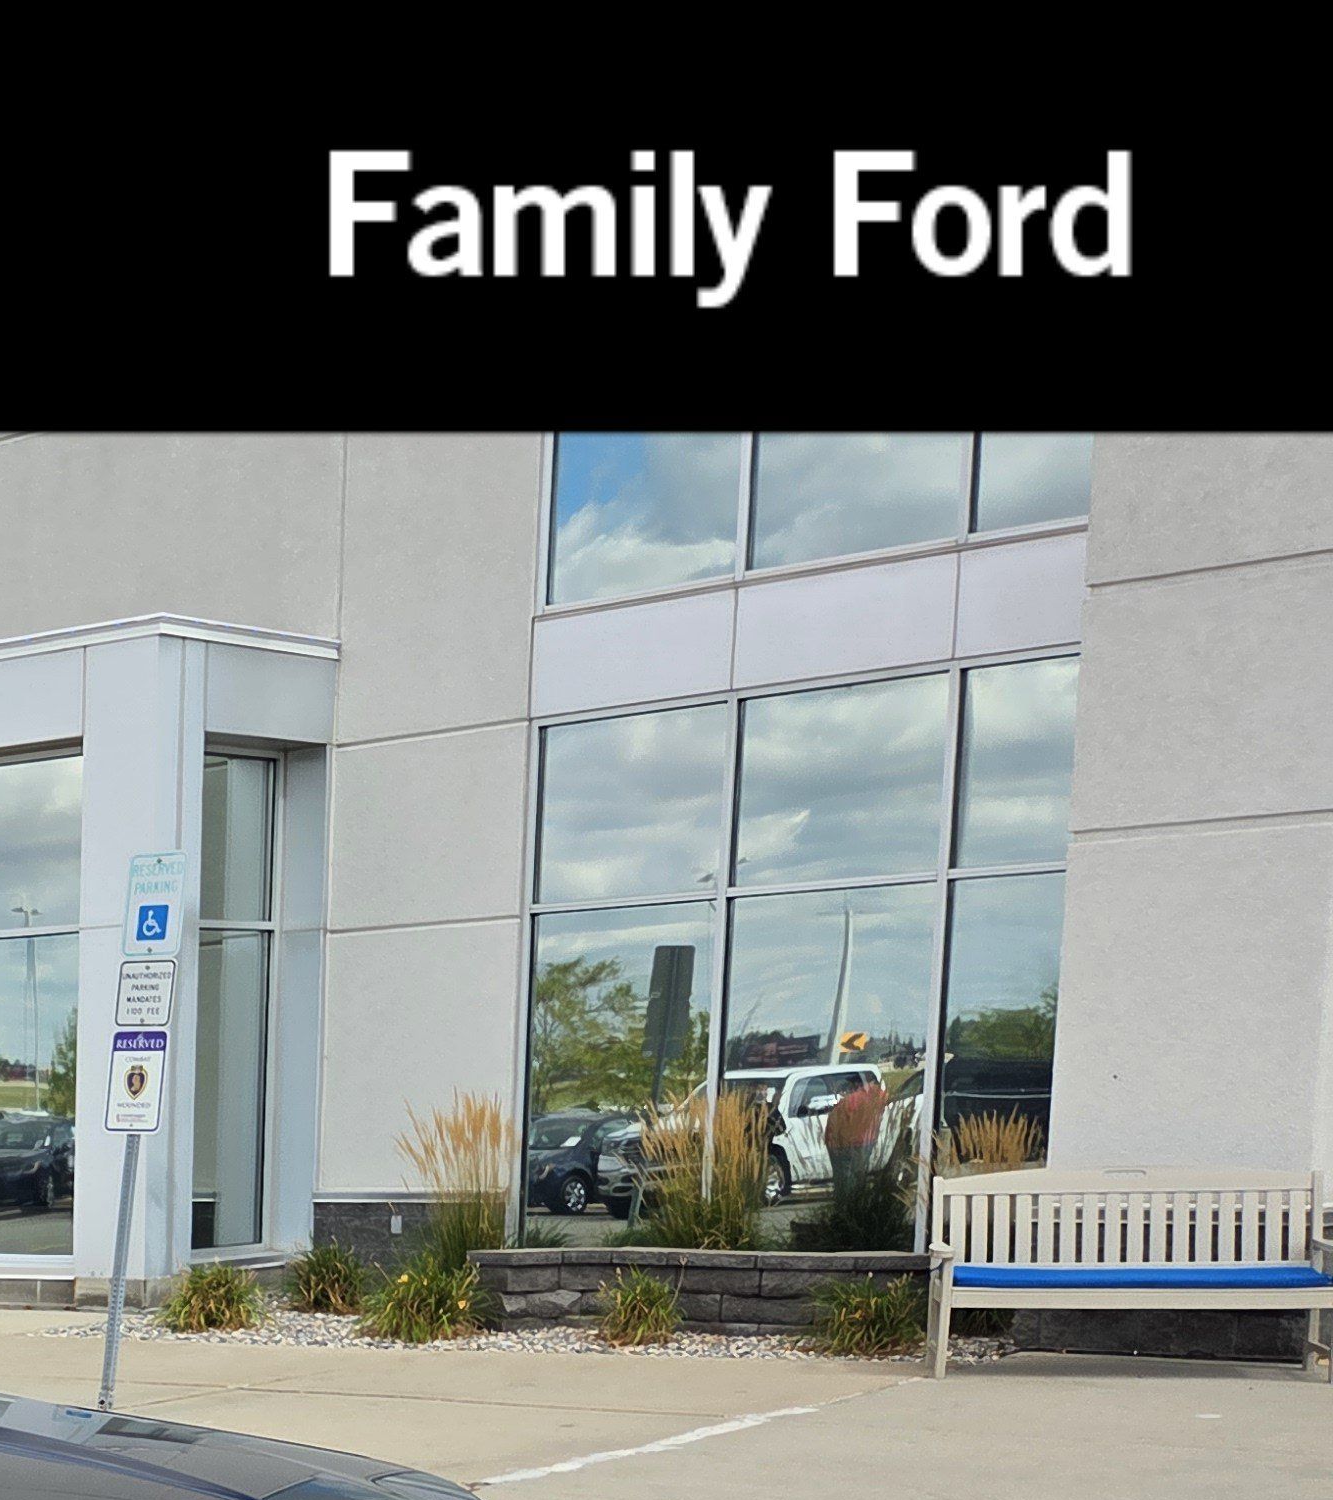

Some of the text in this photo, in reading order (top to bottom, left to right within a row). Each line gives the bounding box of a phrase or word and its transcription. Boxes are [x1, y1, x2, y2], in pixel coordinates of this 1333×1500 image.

[132, 861, 184, 877] RESERVED
[134, 880, 178, 895] PARKING
[130, 983, 160, 991] PARKING
[126, 995, 162, 1004] MANDATES
[115, 1038, 165, 1050] RESERVED
